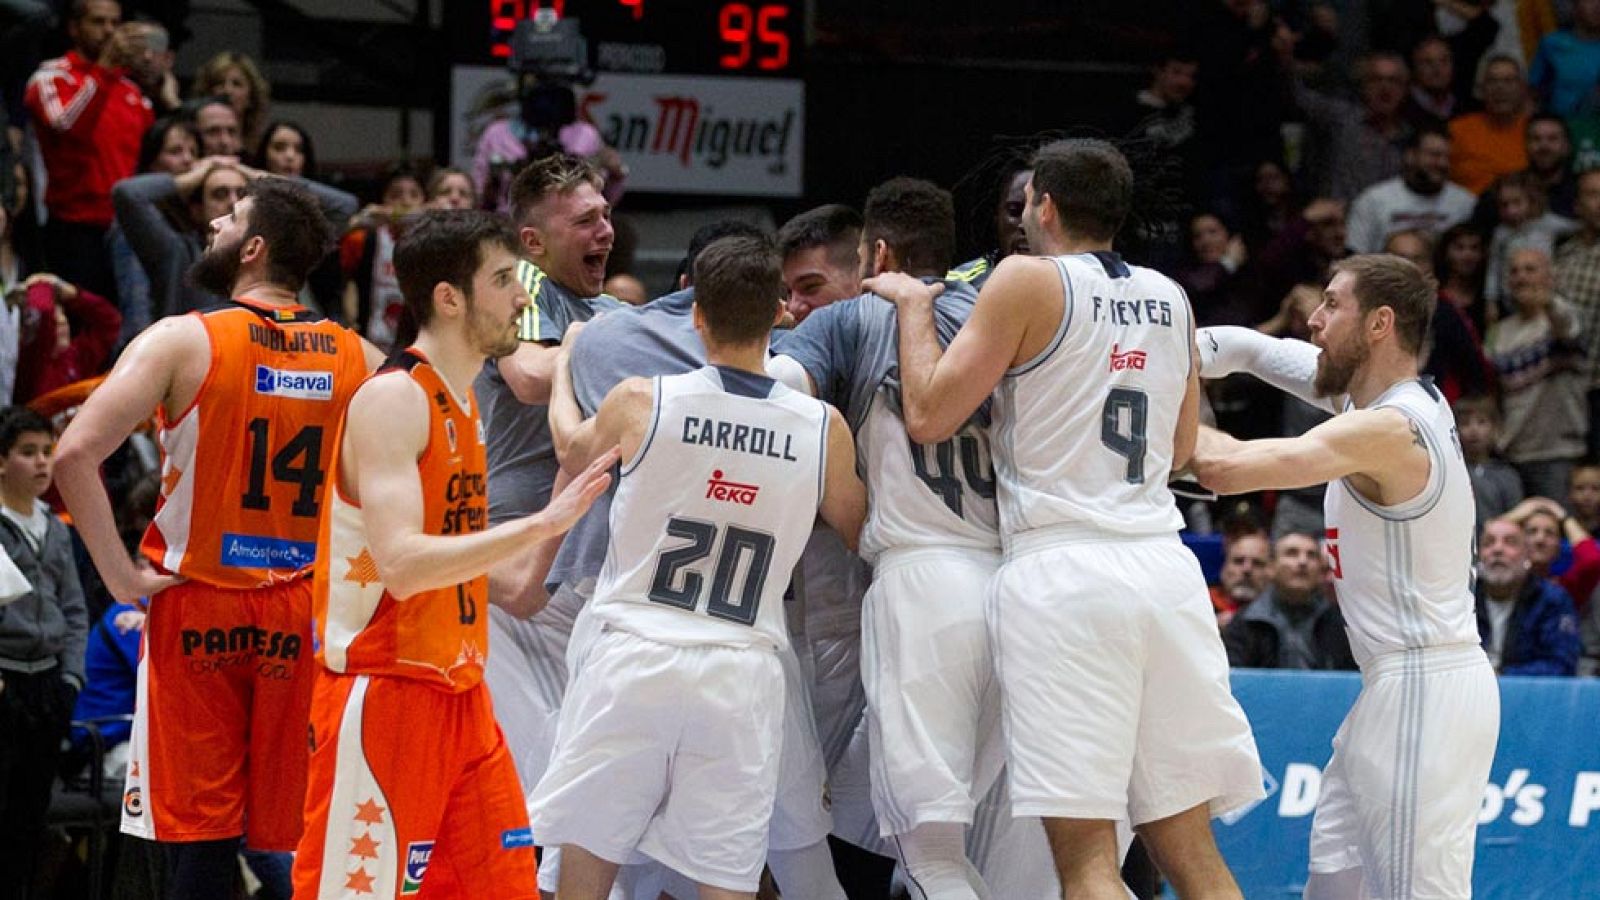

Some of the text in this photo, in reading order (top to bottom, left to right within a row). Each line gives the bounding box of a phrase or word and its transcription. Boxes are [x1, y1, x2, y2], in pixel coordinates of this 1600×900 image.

[718, 4, 789, 69] 95
[652, 95, 796, 169] Miguel
[247, 322, 337, 355] DUBLJEVIC
[277, 371, 332, 391] isaval
[241, 417, 325, 518] 14
[681, 416, 798, 462] CARROLL
[1101, 385, 1149, 485] 9
[647, 515, 777, 627] 20
[180, 624, 302, 662] PAMESA
